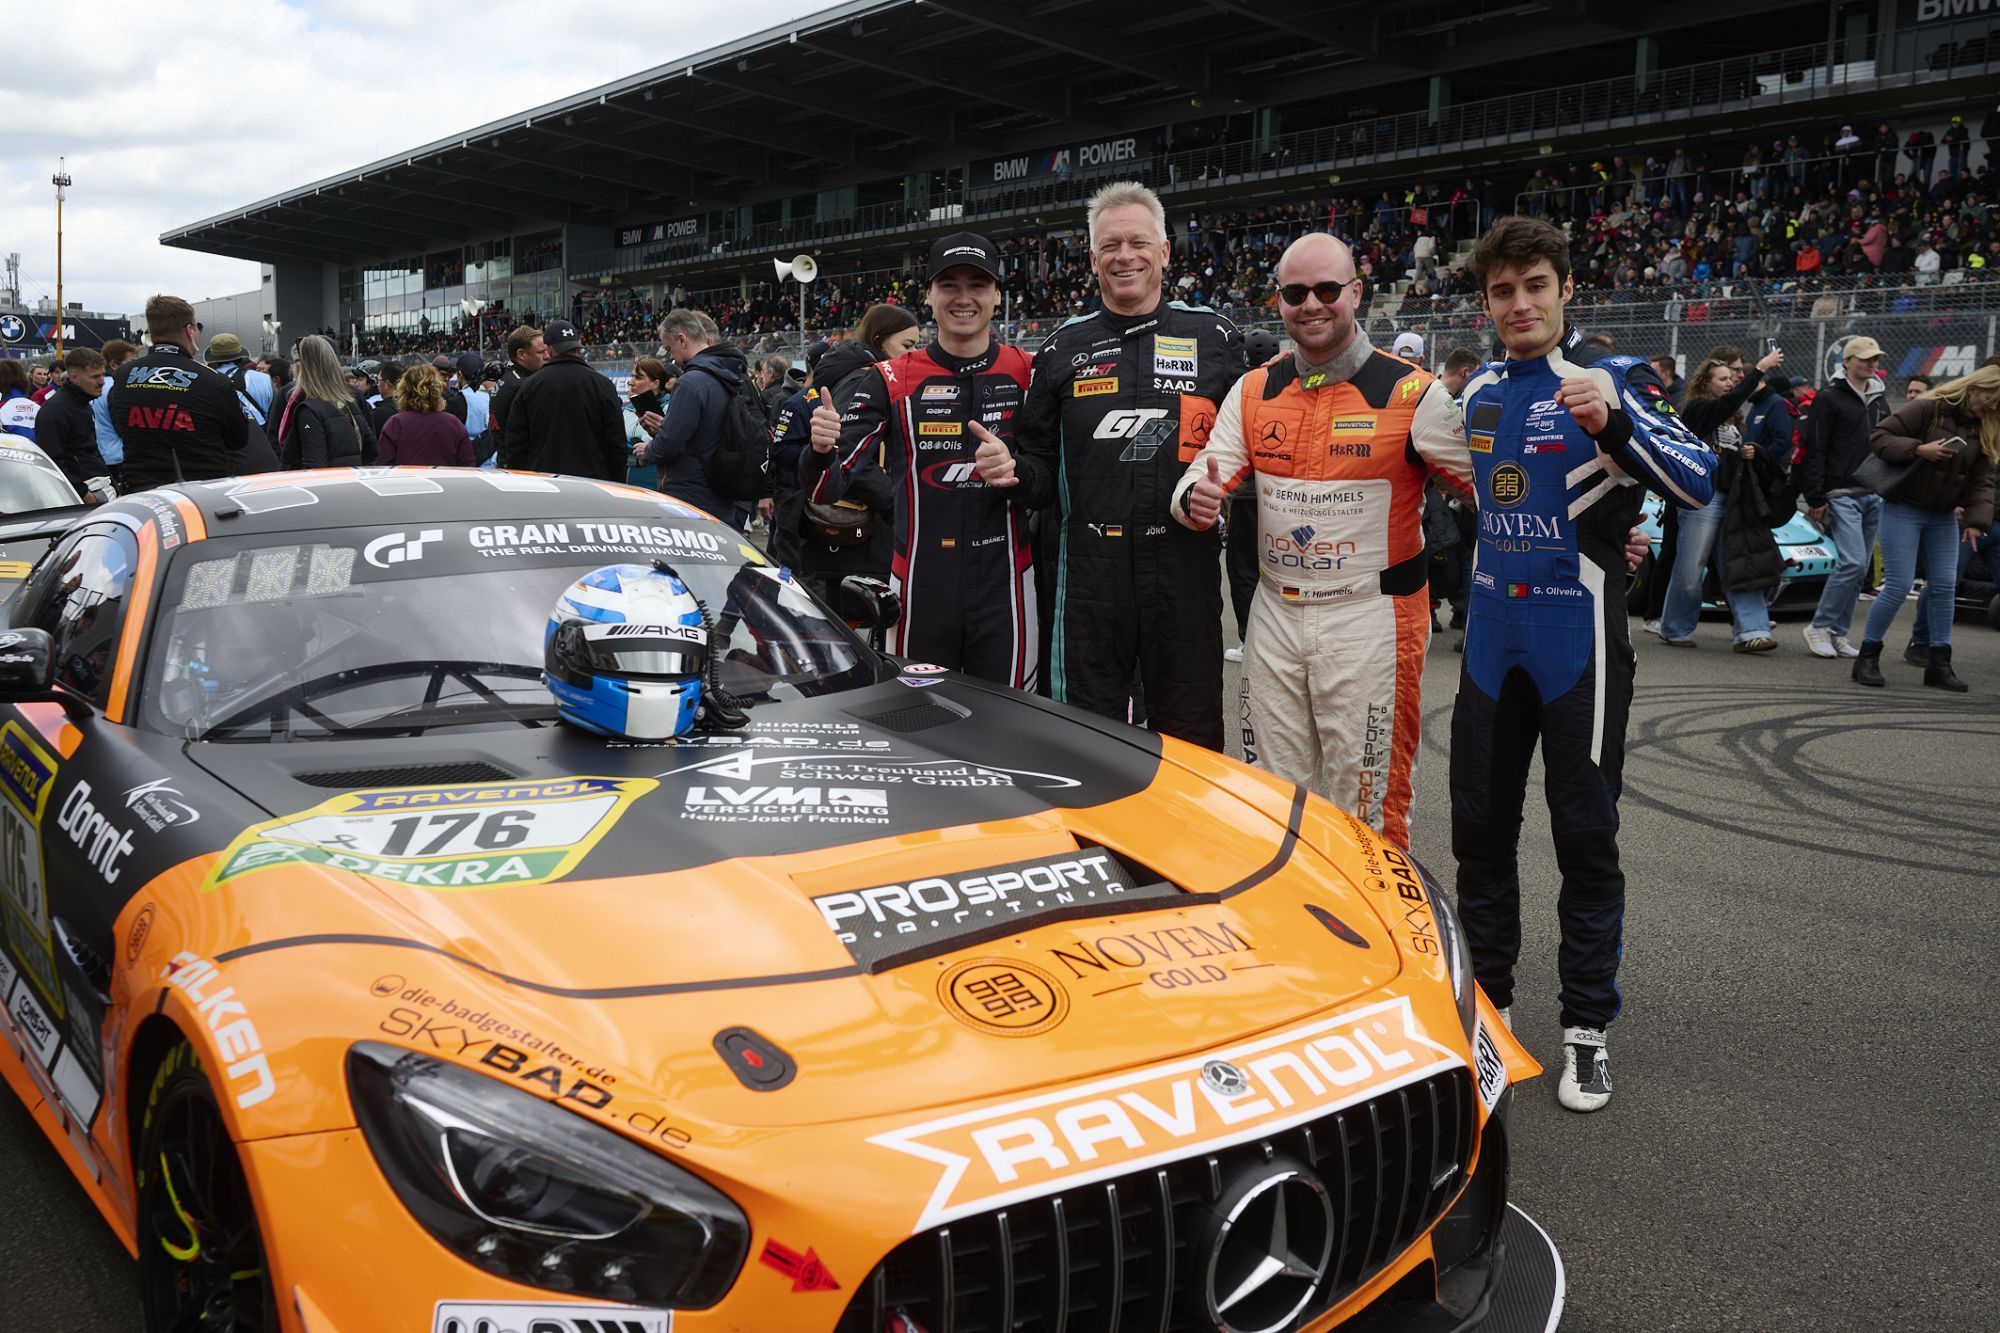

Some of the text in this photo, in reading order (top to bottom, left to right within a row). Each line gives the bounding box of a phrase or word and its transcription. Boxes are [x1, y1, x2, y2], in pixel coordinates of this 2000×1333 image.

[994, 157, 1029, 181] BMW
[1080, 138, 1136, 166] POWER
[623, 229, 641, 245] BMW
[667, 219, 697, 237] POWER
[1156, 358, 1179, 370] H&R
[126, 367, 198, 388] W&S
[1153, 377, 1196, 392] SAAD
[126, 383, 189, 391] MOTORSPORT
[1078, 382, 1113, 393] PIRELLI
[1402, 378, 1420, 399] P1
[923, 424, 958, 433] PIRELLI
[1330, 444, 1354, 456] H&R
[1471, 438, 1490, 450] PIRELLI
[1261, 450, 1292, 460] AMG
[1276, 490, 1364, 504] BERND HIMMELS
[1146, 526, 1167, 535] JÖRG
[1482, 509, 1562, 539] NOVEM
[469, 523, 567, 548] GRAN
[1265, 533, 1355, 555] noven
[477, 544, 728, 562] THE REAL DRIVING SIMULATOR
[1495, 540, 1531, 552] GOLD
[1313, 588, 1353, 598] Himmels
[1533, 586, 1583, 597] G. Oliveira
[640, 625, 699, 641] AMG
[756, 722, 860, 730] HIMMELS
[677, 735, 890, 748] YBAD.de
[1363, 703, 1380, 768] SPORT
[779, 769, 1016, 788] Schweiz GmbH
[780, 762, 969, 777] Lkm Treuhand
[372, 780, 606, 808] RAVENOL
[684, 786, 822, 806] LVM
[680, 812, 890, 824] Heinz-Josef Frenken
[685, 805, 889, 815] VERSICHERUNG
[57, 779, 135, 884] Dorint
[378, 810, 537, 857] 176
[323, 854, 534, 887] DEKRA
[814, 855, 1112, 932] PRO SPORT
[1049, 922, 1257, 980] NOVEM
[1148, 963, 1229, 990] GOLD
[400, 985, 617, 1086] die-badgestalter.de
[379, 1007, 692, 1149] SKYBAD.de
